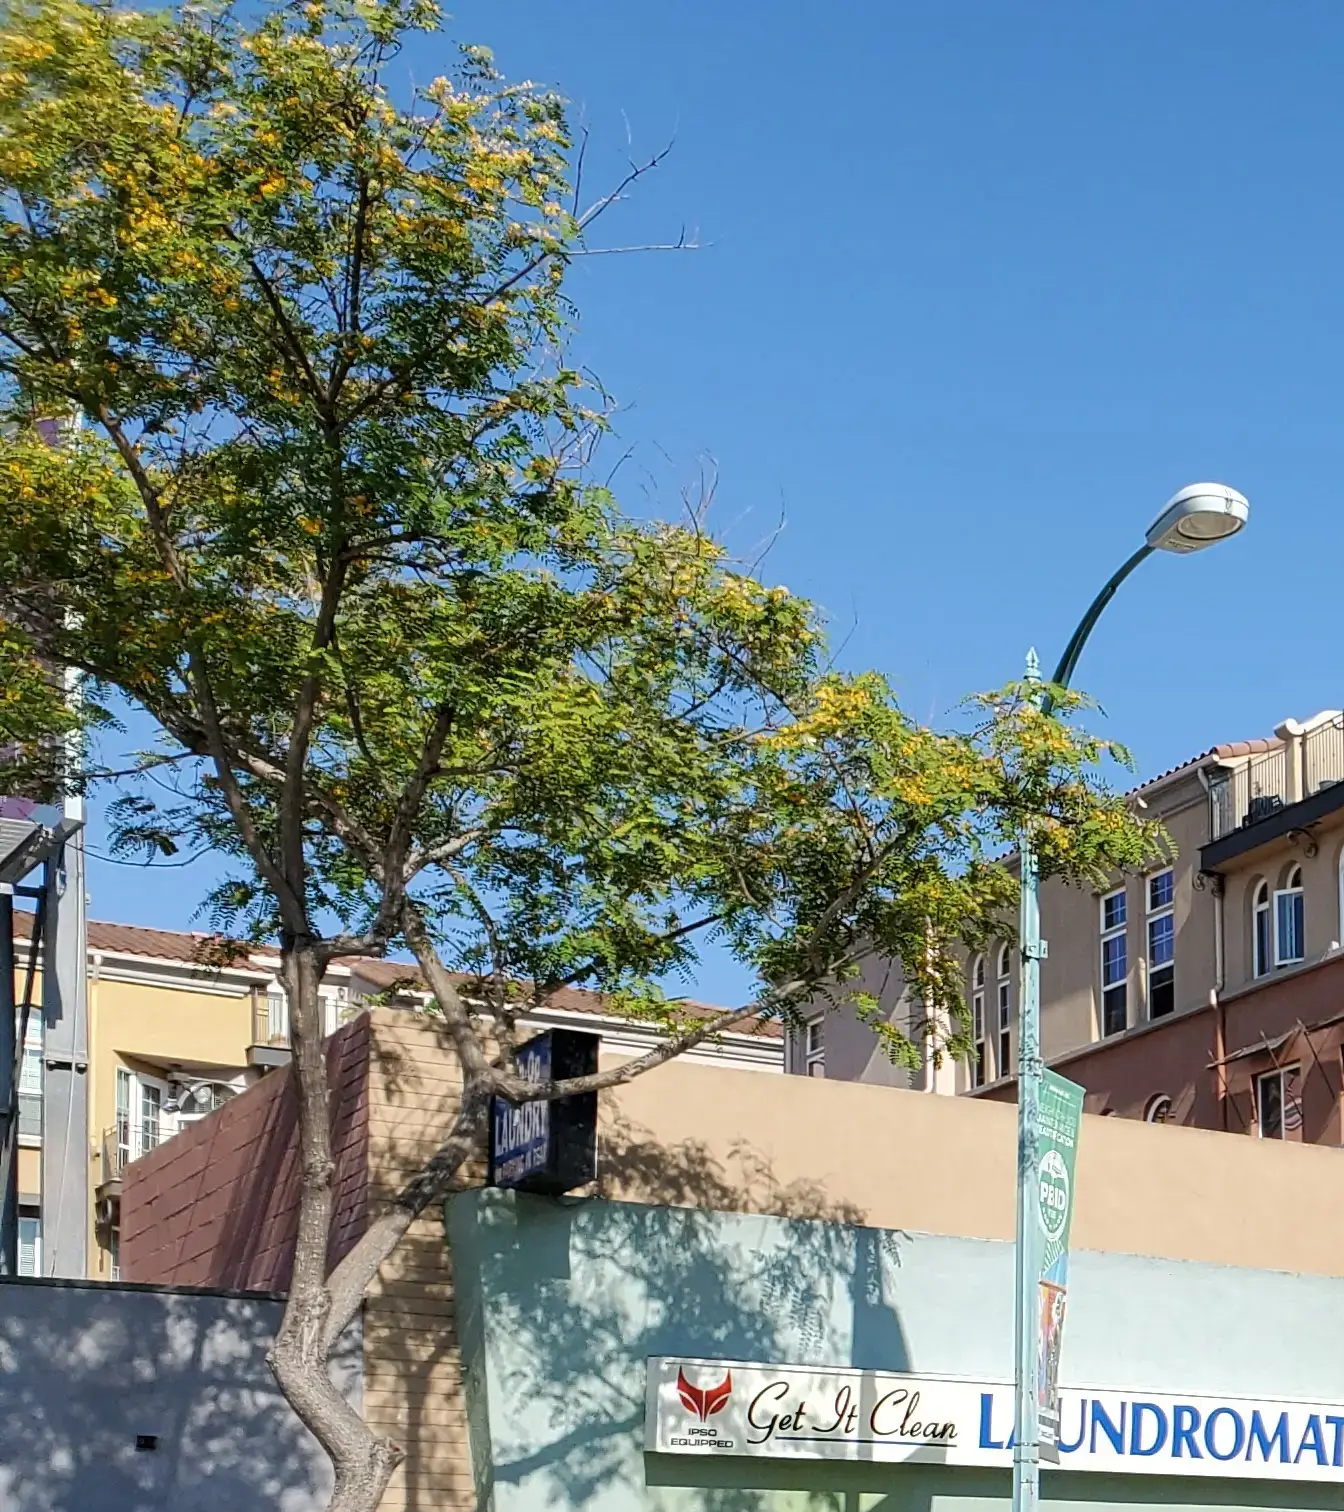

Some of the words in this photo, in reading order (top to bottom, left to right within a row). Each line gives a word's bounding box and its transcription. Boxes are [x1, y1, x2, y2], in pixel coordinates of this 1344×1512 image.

[495, 1100, 547, 1157] LAUNDRY
[1040, 1182, 1066, 1211] PBID
[747, 1381, 806, 1444] Get
[811, 1385, 858, 1434] It
[870, 1388, 958, 1440] Clean
[671, 1437, 734, 1449] EQUIPPED
[688, 1428, 717, 1437] IPSO
